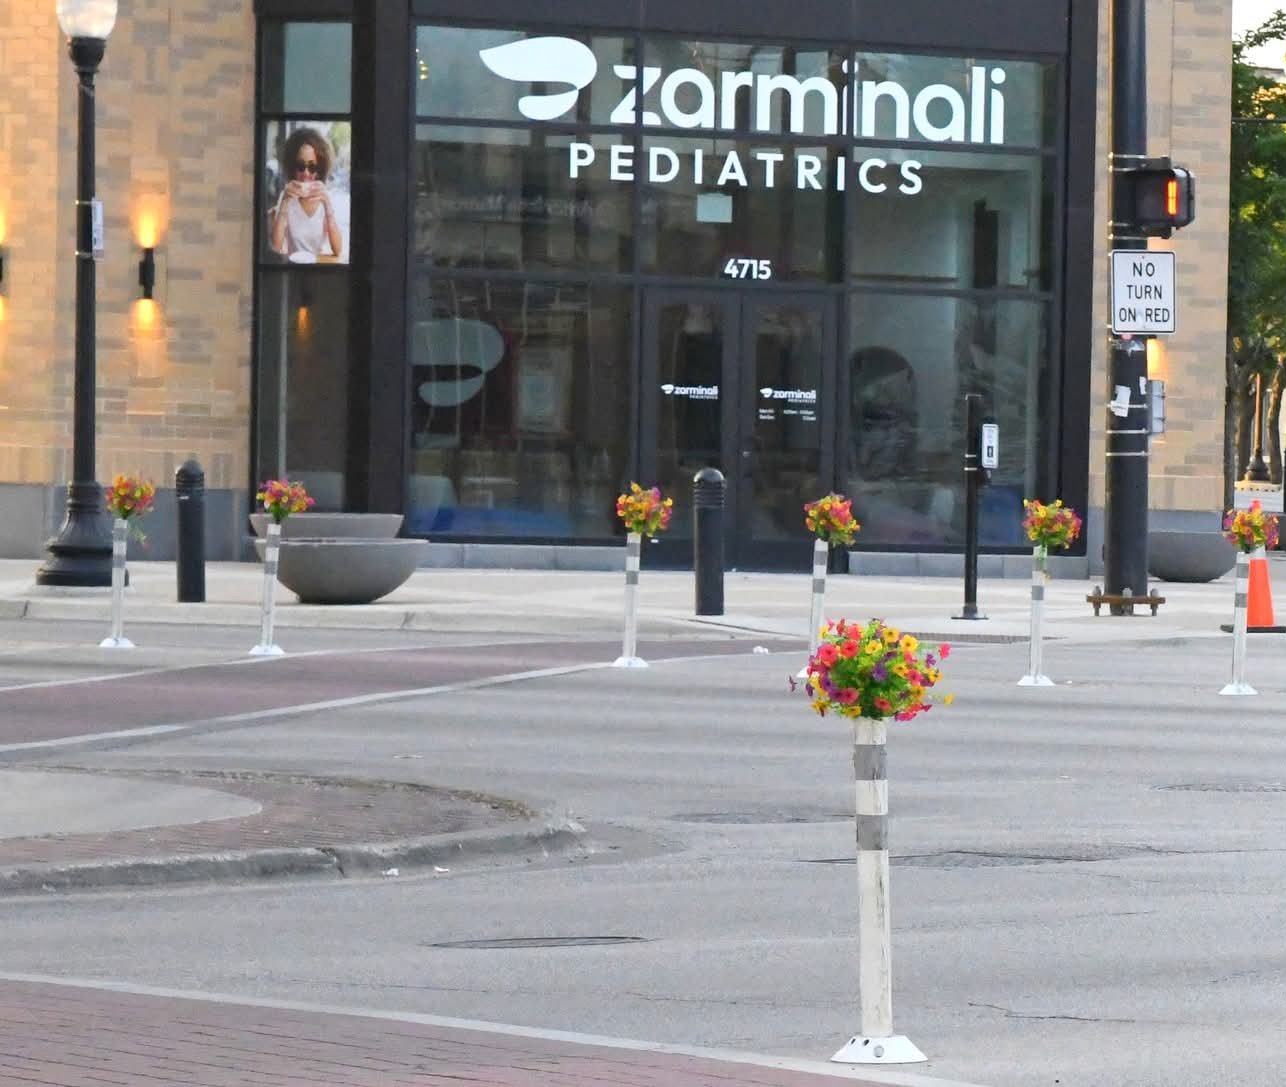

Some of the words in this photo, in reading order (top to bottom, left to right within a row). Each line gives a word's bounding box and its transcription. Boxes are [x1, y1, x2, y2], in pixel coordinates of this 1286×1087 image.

[610, 59, 1007, 144] zarminali
[569, 142, 923, 196] PEDIATRICS
[724, 258, 772, 280] 4715
[1132, 262, 1155, 277] NO
[1126, 284, 1163, 300] TURN
[1119, 307, 1137, 323] ON
[1145, 307, 1171, 323] RED
